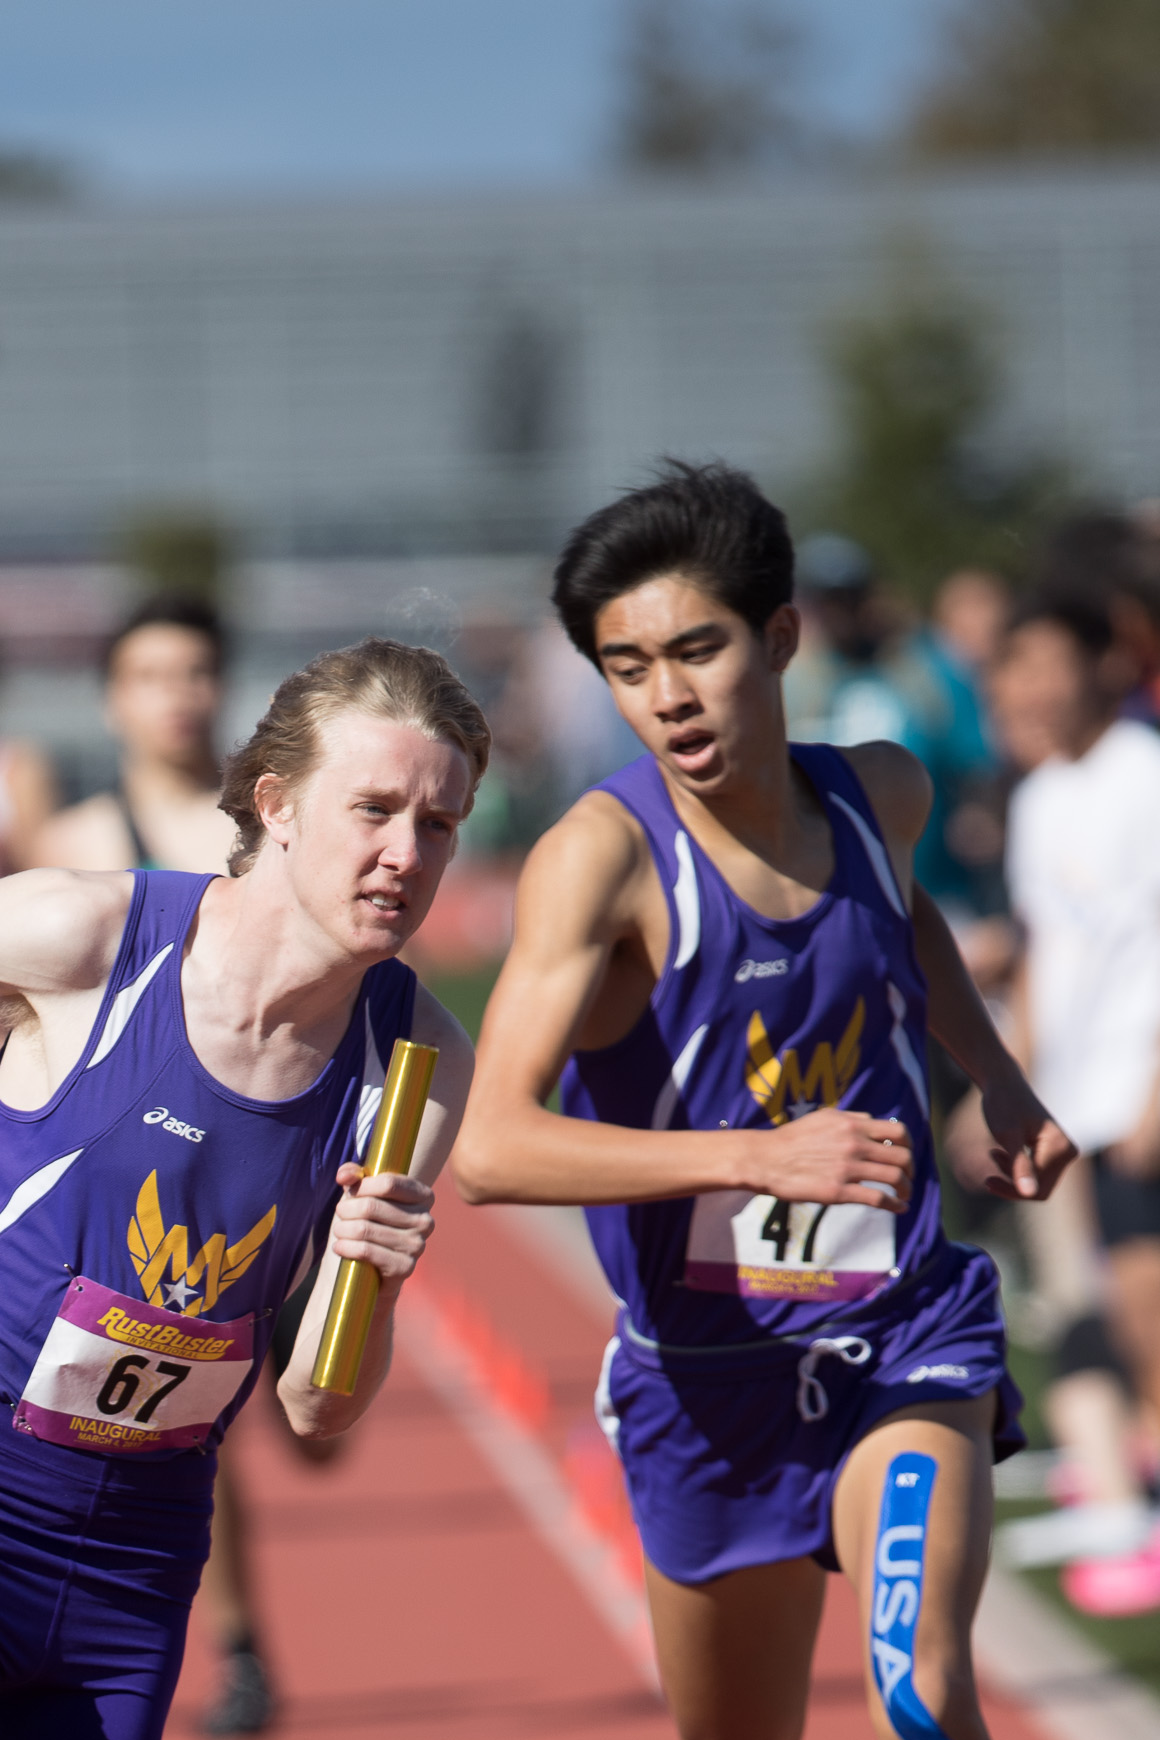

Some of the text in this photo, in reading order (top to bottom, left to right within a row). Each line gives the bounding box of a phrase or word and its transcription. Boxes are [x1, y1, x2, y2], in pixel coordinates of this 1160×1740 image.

[162, 1116, 207, 1143] asics
[760, 1198, 829, 1263] 47
[96, 1306, 235, 1357] RustBuster
[126, 1336, 199, 1359] INVITATIONAL
[96, 1354, 192, 1425] 67
[69, 1416, 161, 1442] INAUGURAL
[77, 1432, 112, 1446] MARCH
[872, 1524, 924, 1709] USA
